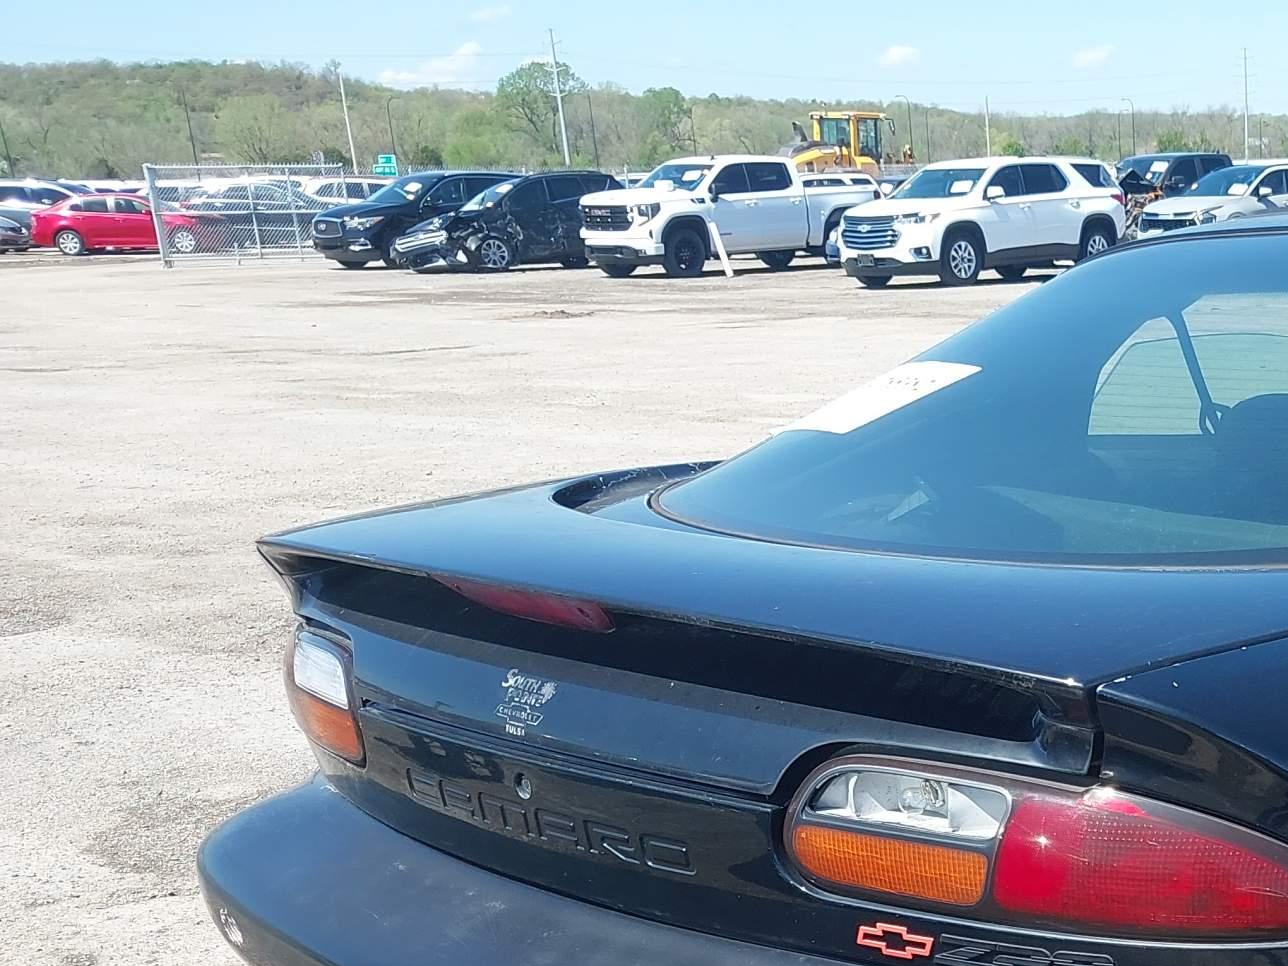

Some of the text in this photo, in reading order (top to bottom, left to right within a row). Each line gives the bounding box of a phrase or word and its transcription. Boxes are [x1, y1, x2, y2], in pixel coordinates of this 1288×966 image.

[501, 668, 542, 693] SOUTH
[498, 706, 539, 722] CHEVROLET
[505, 724, 526, 737] TULSA
[405, 767, 697, 876] CAMARO
